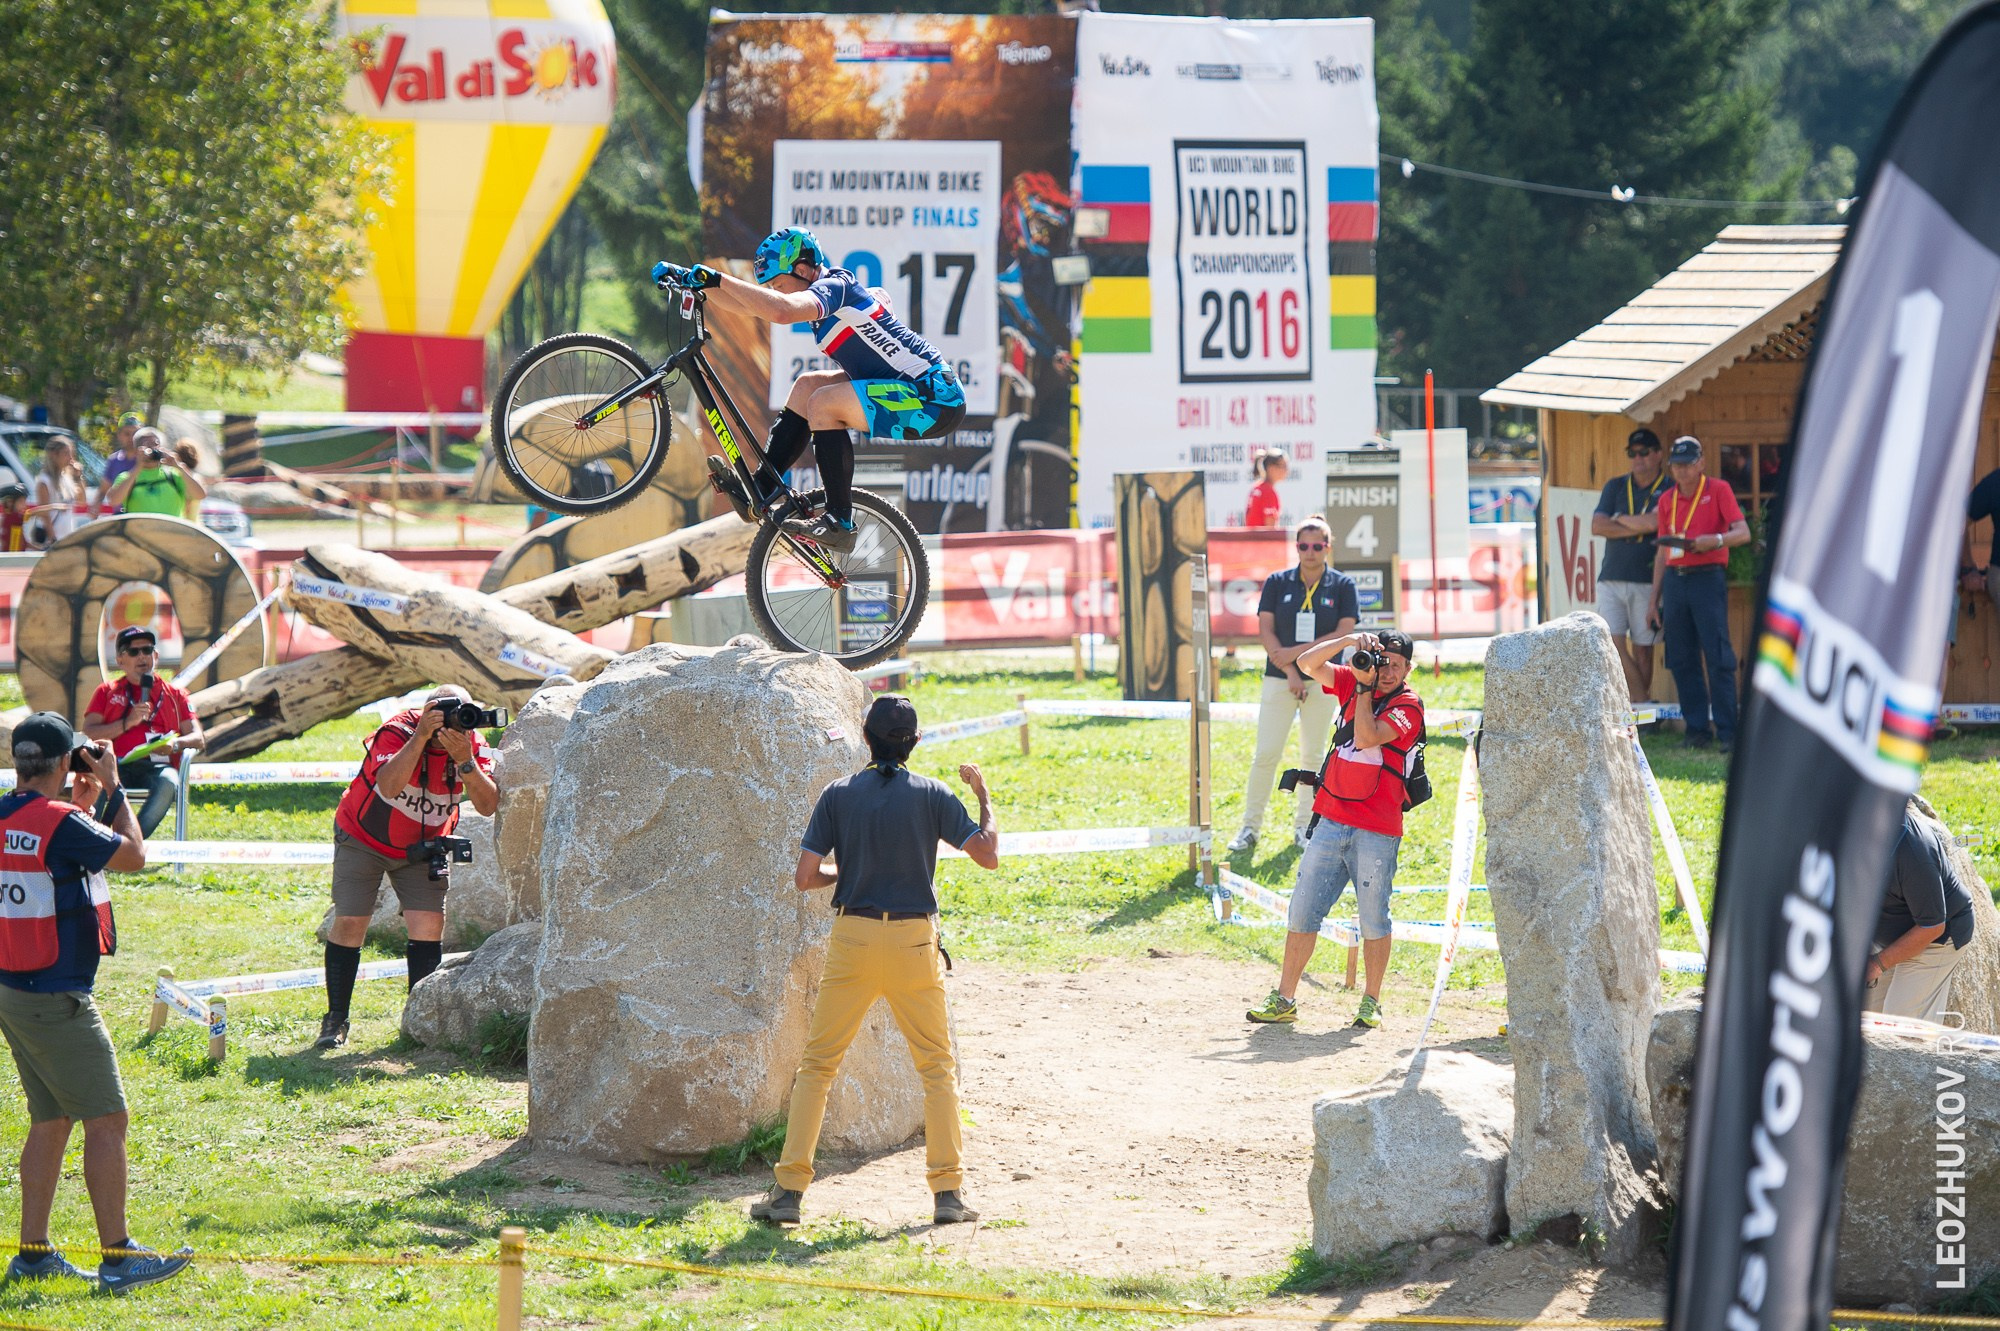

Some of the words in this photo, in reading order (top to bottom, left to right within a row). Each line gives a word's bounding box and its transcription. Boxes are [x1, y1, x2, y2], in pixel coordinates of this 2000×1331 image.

[793, 171, 823, 191] UCI
[829, 171, 930, 191] MOUNTAIN
[938, 171, 982, 191] BIKE
[792, 206, 859, 226] WORLD
[866, 207, 903, 226] CUP
[912, 207, 979, 227] FINALS
[1189, 187, 1297, 236] WORLD
[1192, 253, 1297, 273] CHAMPIONSHIPS
[856, 322, 901, 358] FRANCE
[1200, 289, 1300, 360] 2016
[1228, 397, 1249, 427] 4X
[1265, 394, 1317, 426] TRIALS
[1328, 486, 1397, 507] FINISH
[1345, 514, 1379, 557] 4
[1556, 513, 1596, 606] Val
[970, 551, 1066, 624] Val
[1072, 575, 1117, 618] di
[1803, 628, 1878, 744] UCI
[229, 767, 277, 781] TRENTINO
[9, 834, 37, 851] UCI
